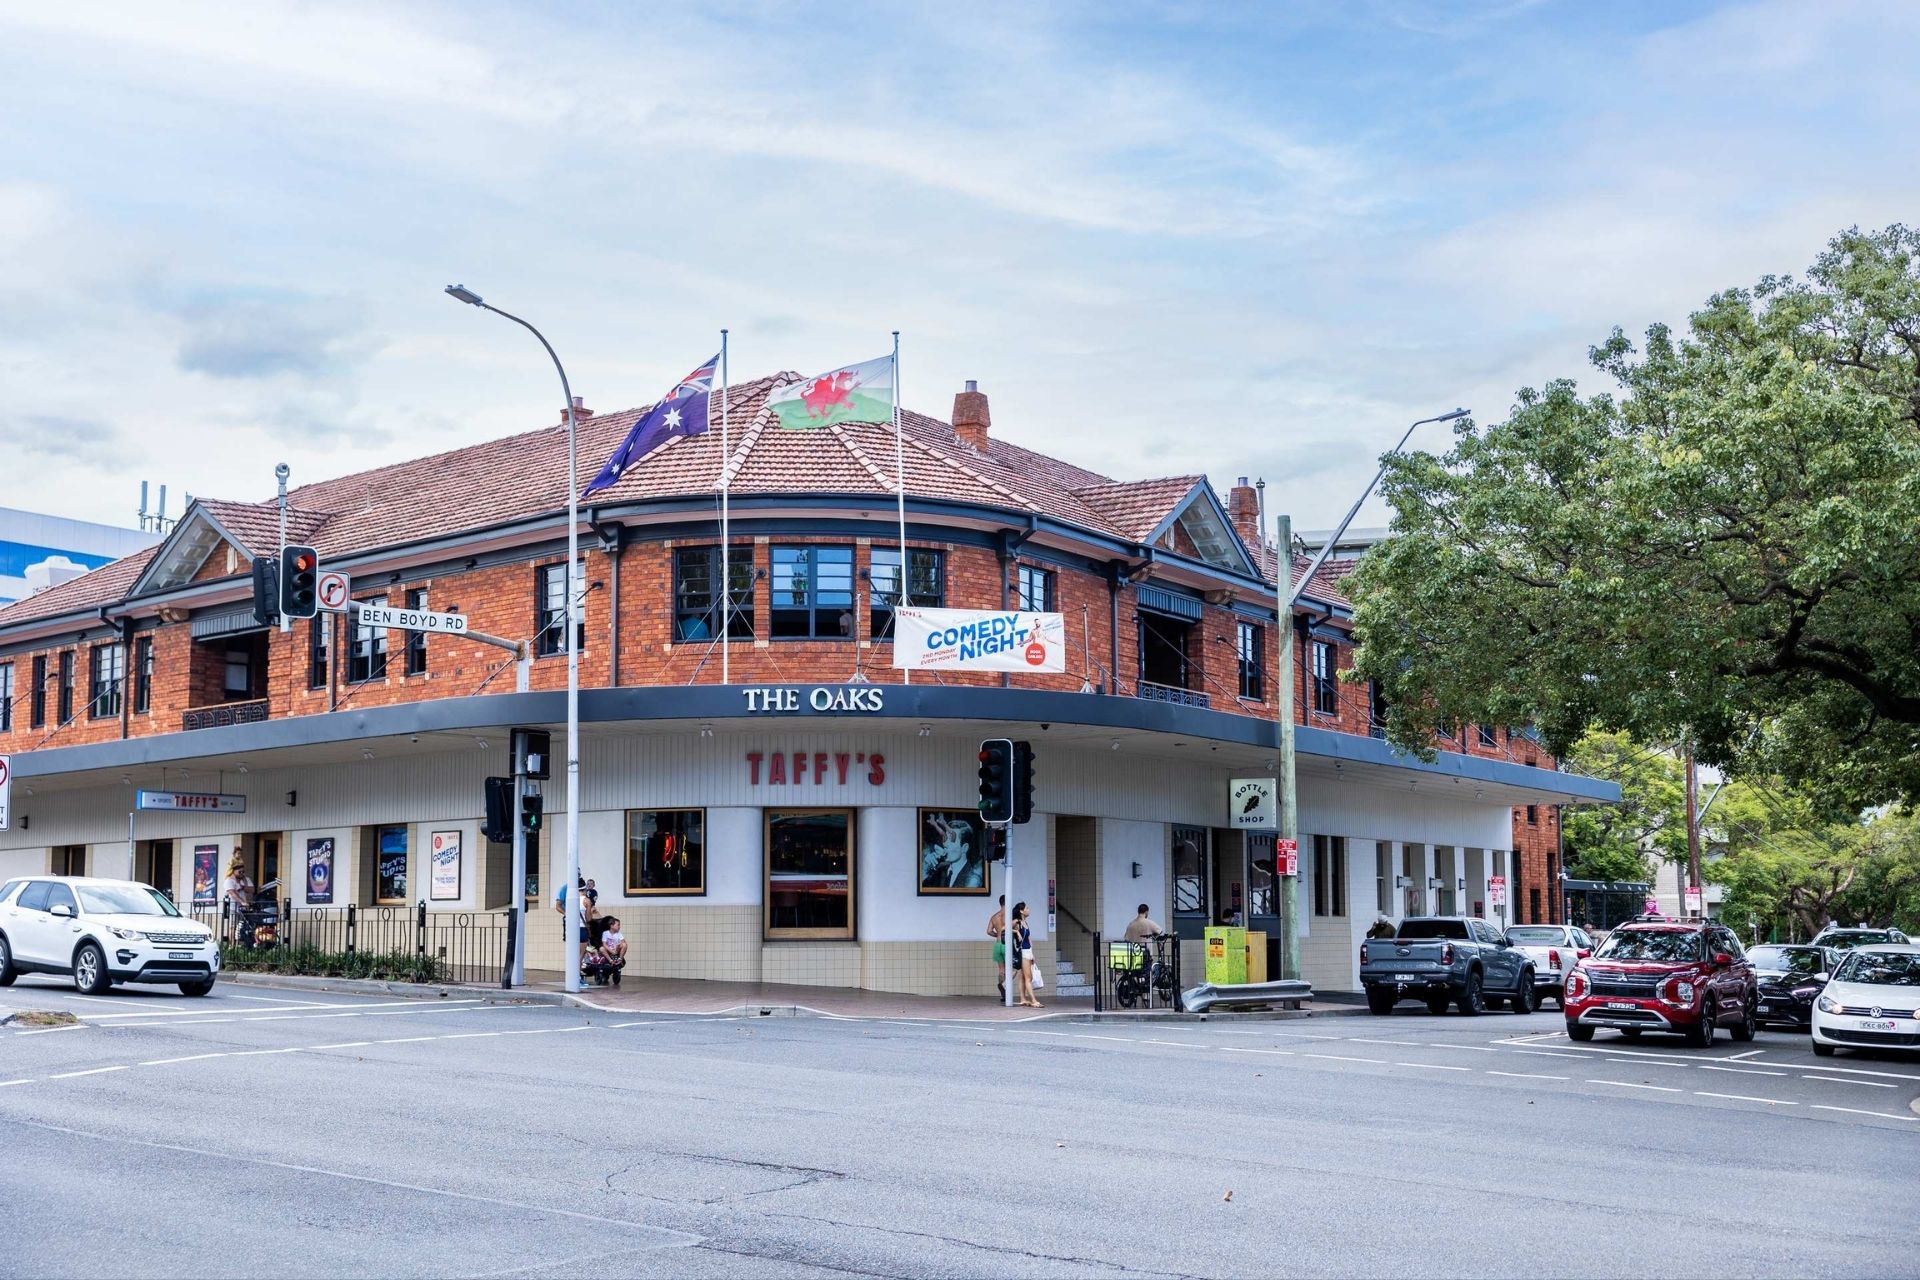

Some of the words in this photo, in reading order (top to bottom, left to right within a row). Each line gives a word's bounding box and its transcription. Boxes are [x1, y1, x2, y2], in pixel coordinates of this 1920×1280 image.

[363, 609, 391, 623] BEN
[400, 613, 437, 627] BOYD
[446, 617, 463, 629] RD
[927, 613, 1019, 650] COMEDY
[934, 648, 957, 656] MONDAY
[959, 629, 1029, 661] NIGHT
[920, 658, 938, 666] EVERY
[938, 654, 958, 663] MONTH
[743, 689, 800, 711] THE
[810, 687, 883, 711] OAKS
[746, 752, 886, 786] TAFFY'S
[1235, 783, 1269, 799] BOTTLE
[174, 795, 219, 809] TAFFY'S
[308, 840, 332, 858] TAFFY'S
[432, 845, 458, 862] COMEDY
[308, 850, 331, 867] STUDIO
[440, 852, 460, 867] NIGHT
